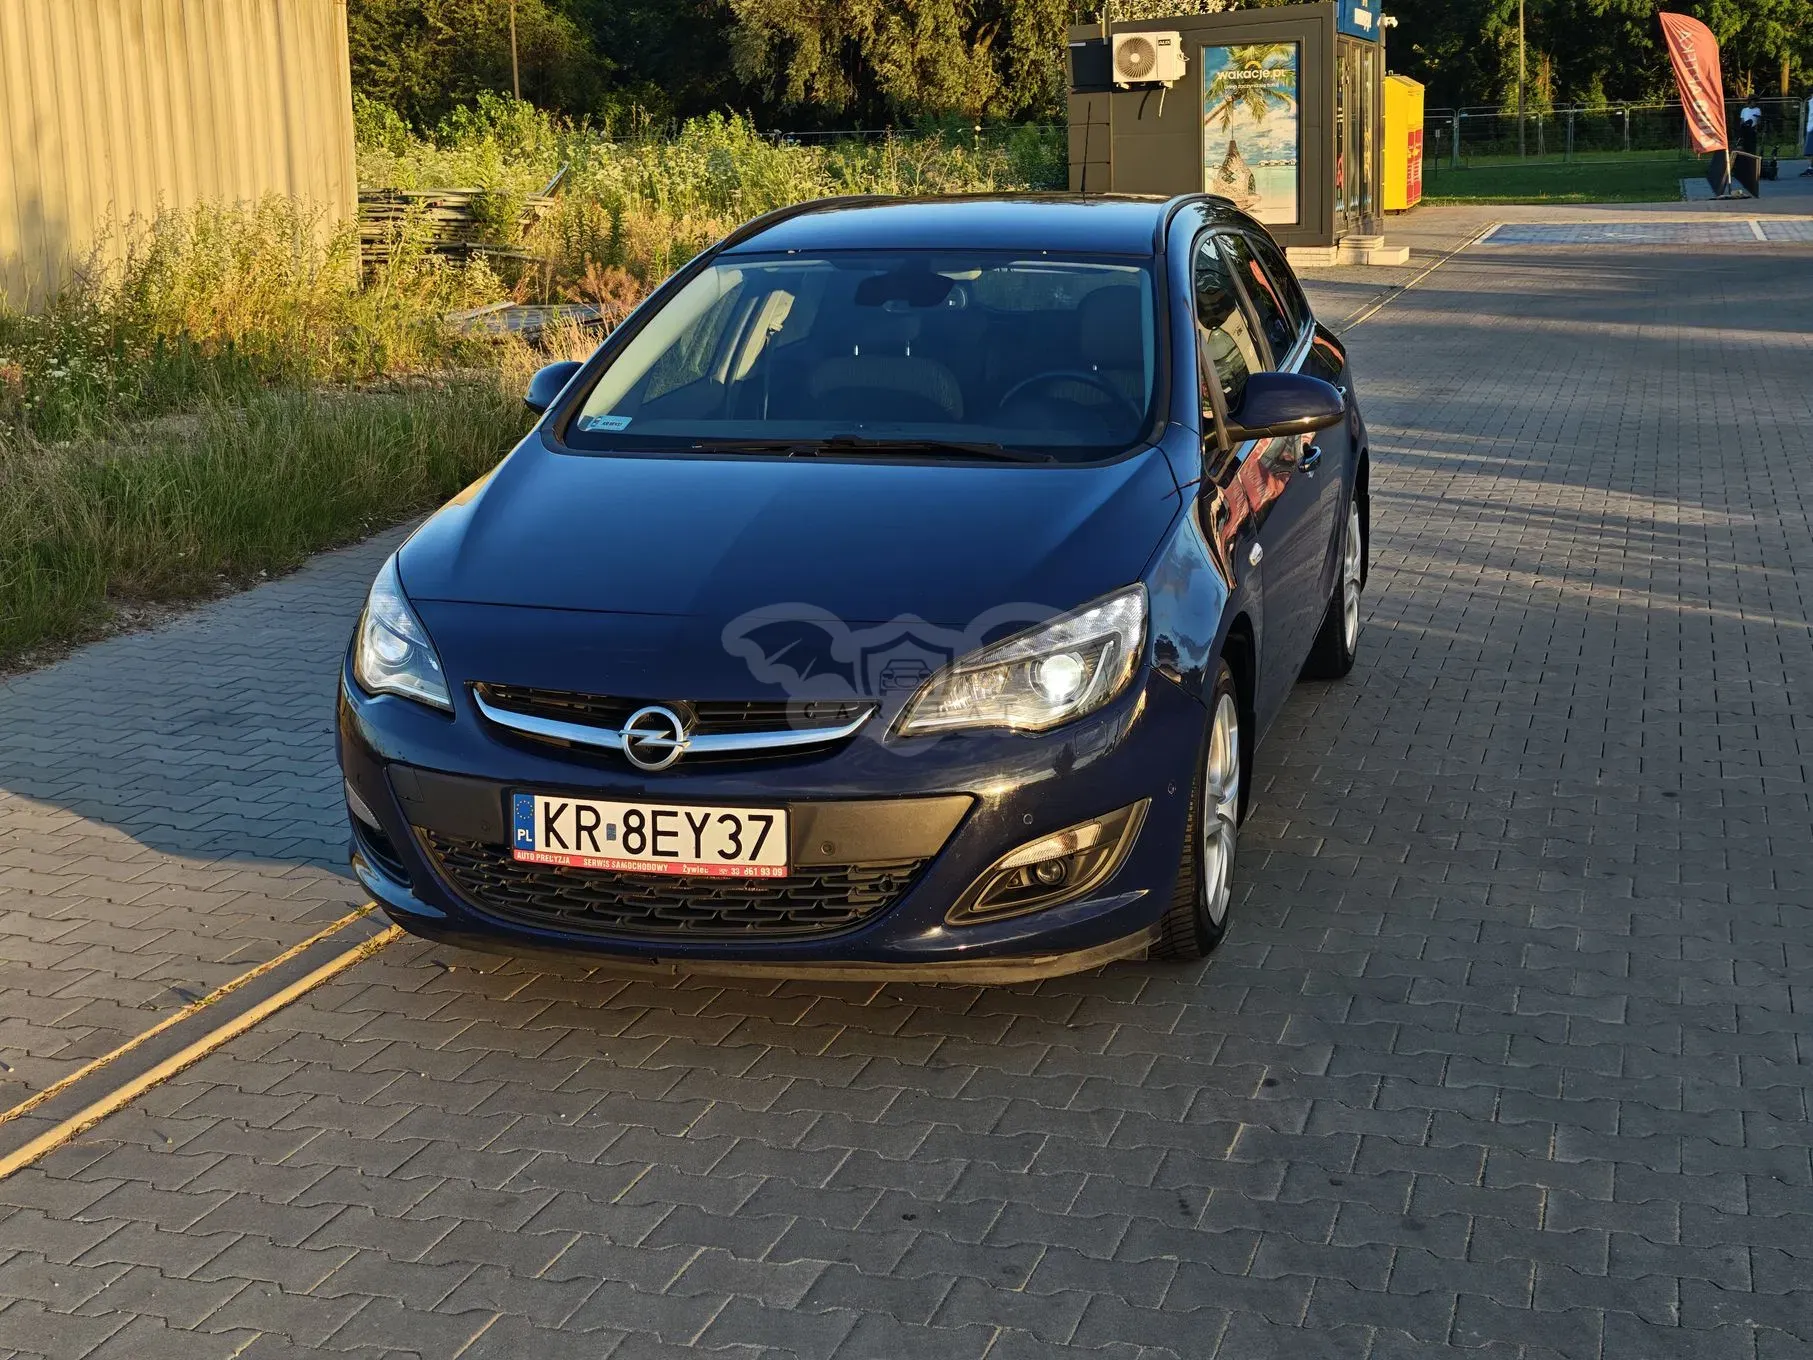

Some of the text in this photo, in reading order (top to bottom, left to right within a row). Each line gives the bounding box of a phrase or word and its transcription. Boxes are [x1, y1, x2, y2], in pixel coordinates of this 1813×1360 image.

[517, 828, 533, 842] PL
[544, 801, 774, 861] KR 8EY37
[517, 851, 535, 861] AUTO
[536, 852, 571, 865] PRECYZJA
[583, 858, 610, 868] SERWIS
[611, 859, 669, 873] SAMOCHODOWY
[731, 867, 740, 875] 33
[760, 867, 771, 876] 93
[772, 867, 783, 877] 09
